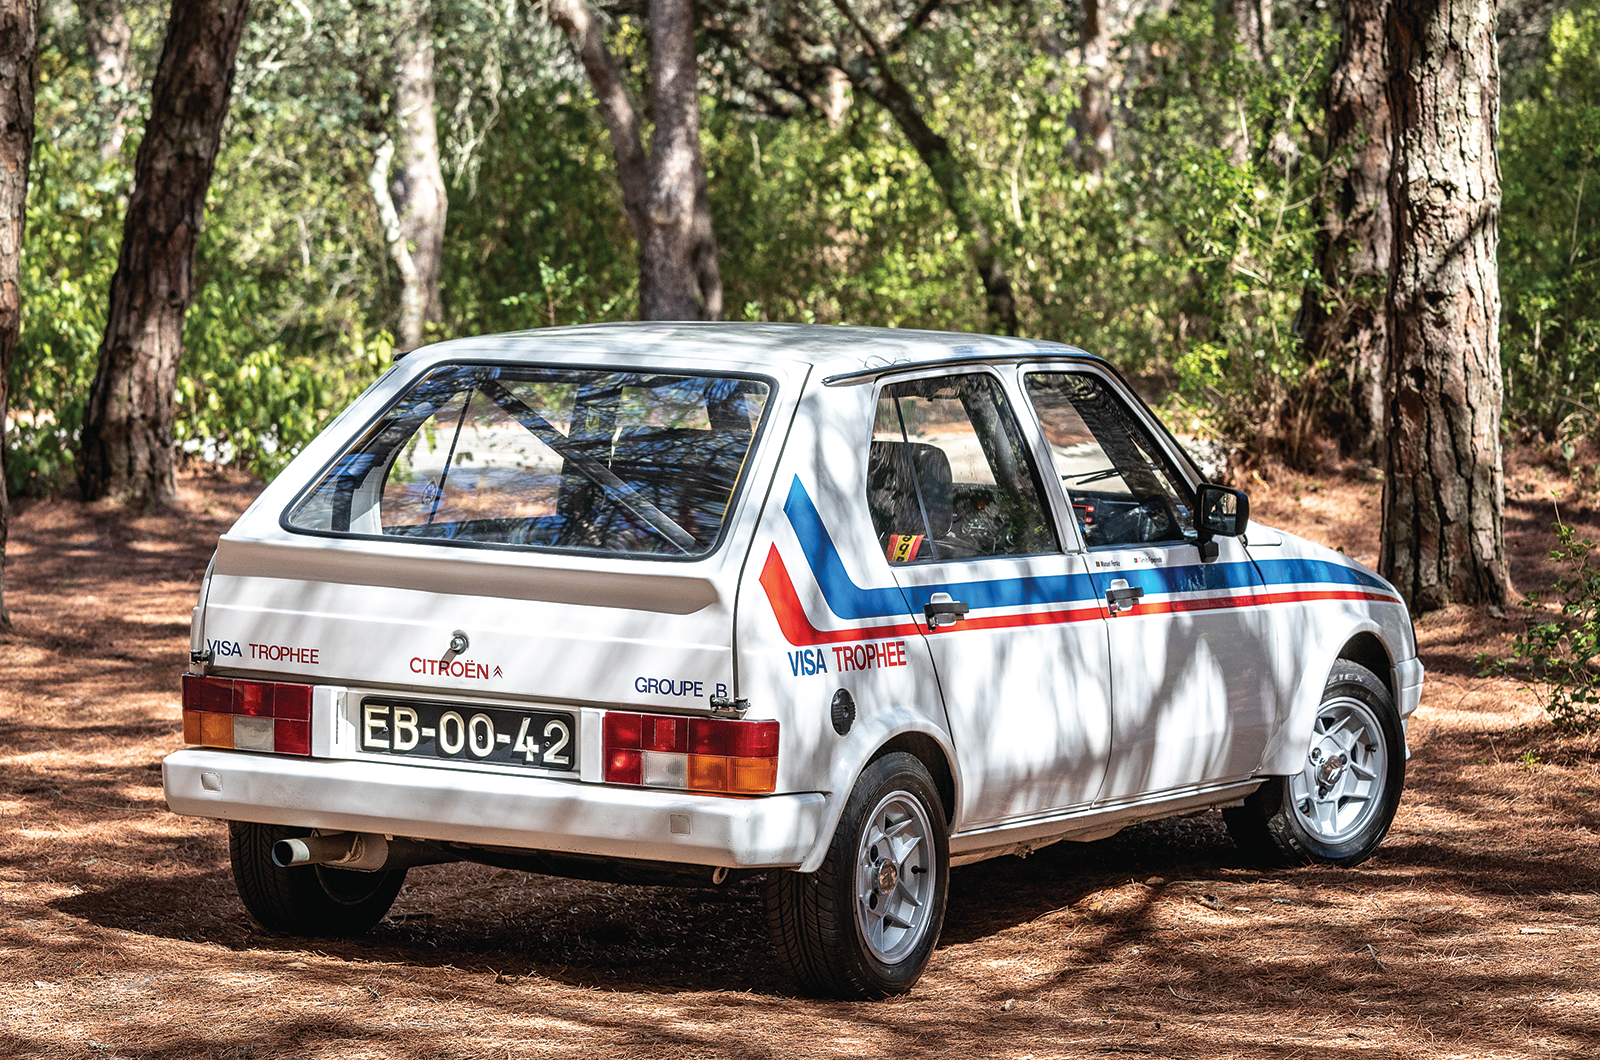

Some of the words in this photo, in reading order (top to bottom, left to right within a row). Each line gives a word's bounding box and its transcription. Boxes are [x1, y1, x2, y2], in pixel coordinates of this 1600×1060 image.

[207, 639, 242, 657] VISA
[249, 643, 319, 664] TROPHEE
[788, 648, 827, 677] VISA
[832, 641, 907, 672] TROPHEE
[410, 656, 489, 680] CITROËN
[1327, 673, 1364, 685] ZIEX
[634, 676, 704, 698] GROUPE
[716, 683, 728, 698] B
[363, 704, 571, 765] EB-00-42
